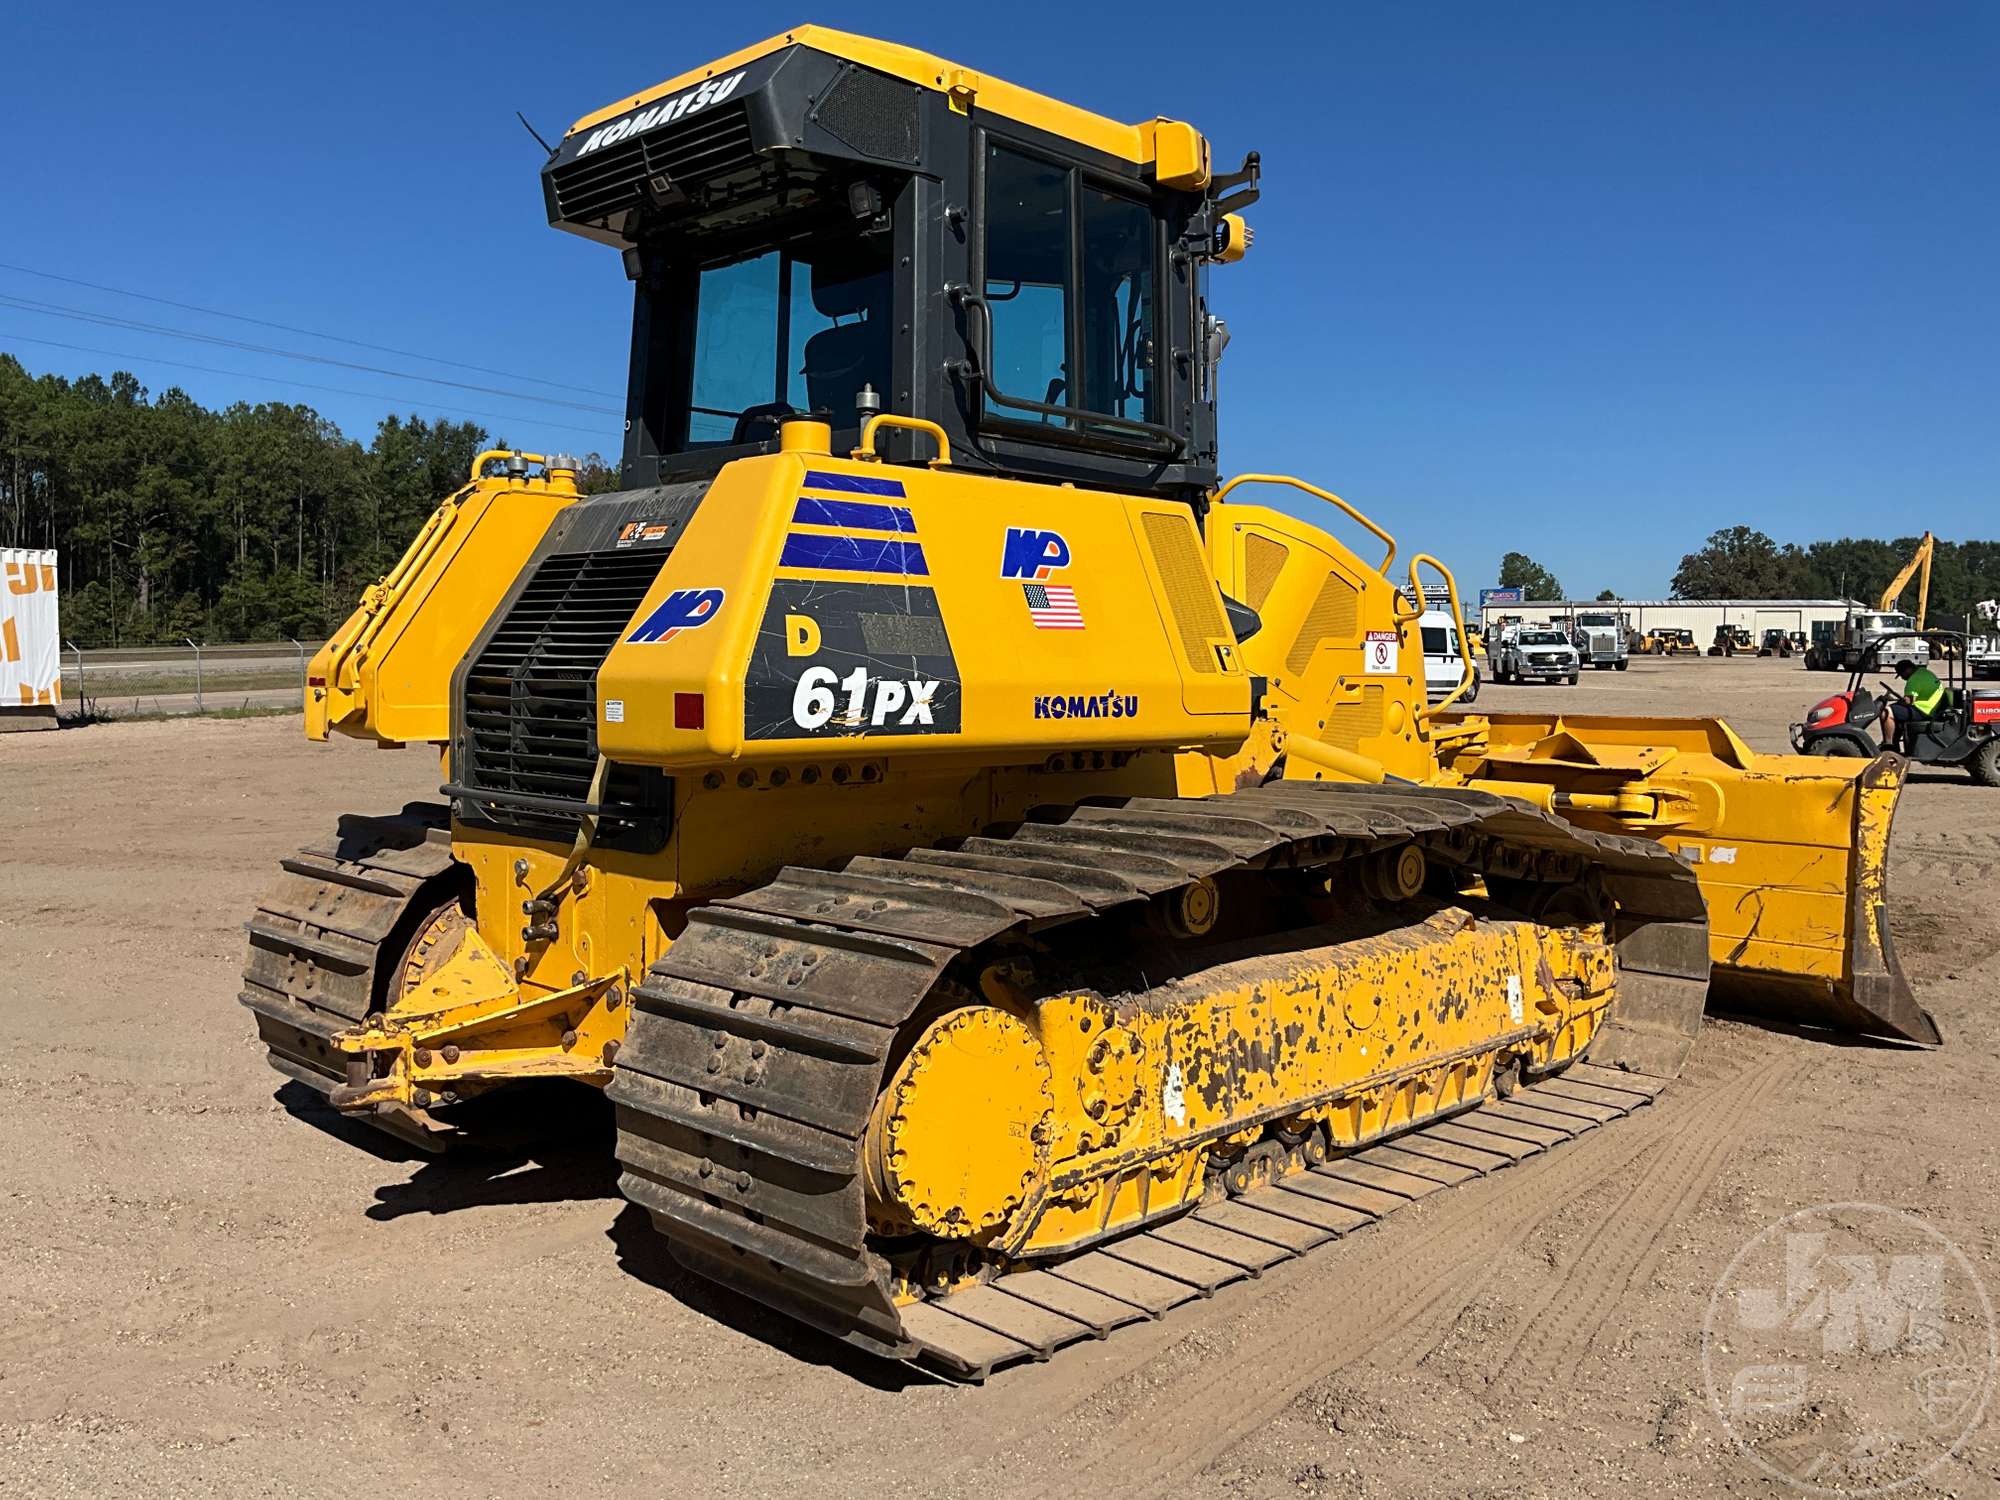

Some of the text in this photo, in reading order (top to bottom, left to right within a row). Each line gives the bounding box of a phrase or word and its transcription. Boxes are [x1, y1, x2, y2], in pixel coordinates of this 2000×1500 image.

[576, 71, 747, 157] KOMATSU
[785, 614, 822, 657] D
[1373, 631, 1397, 641] DANGER
[1034, 690, 1138, 719] KOMATSU
